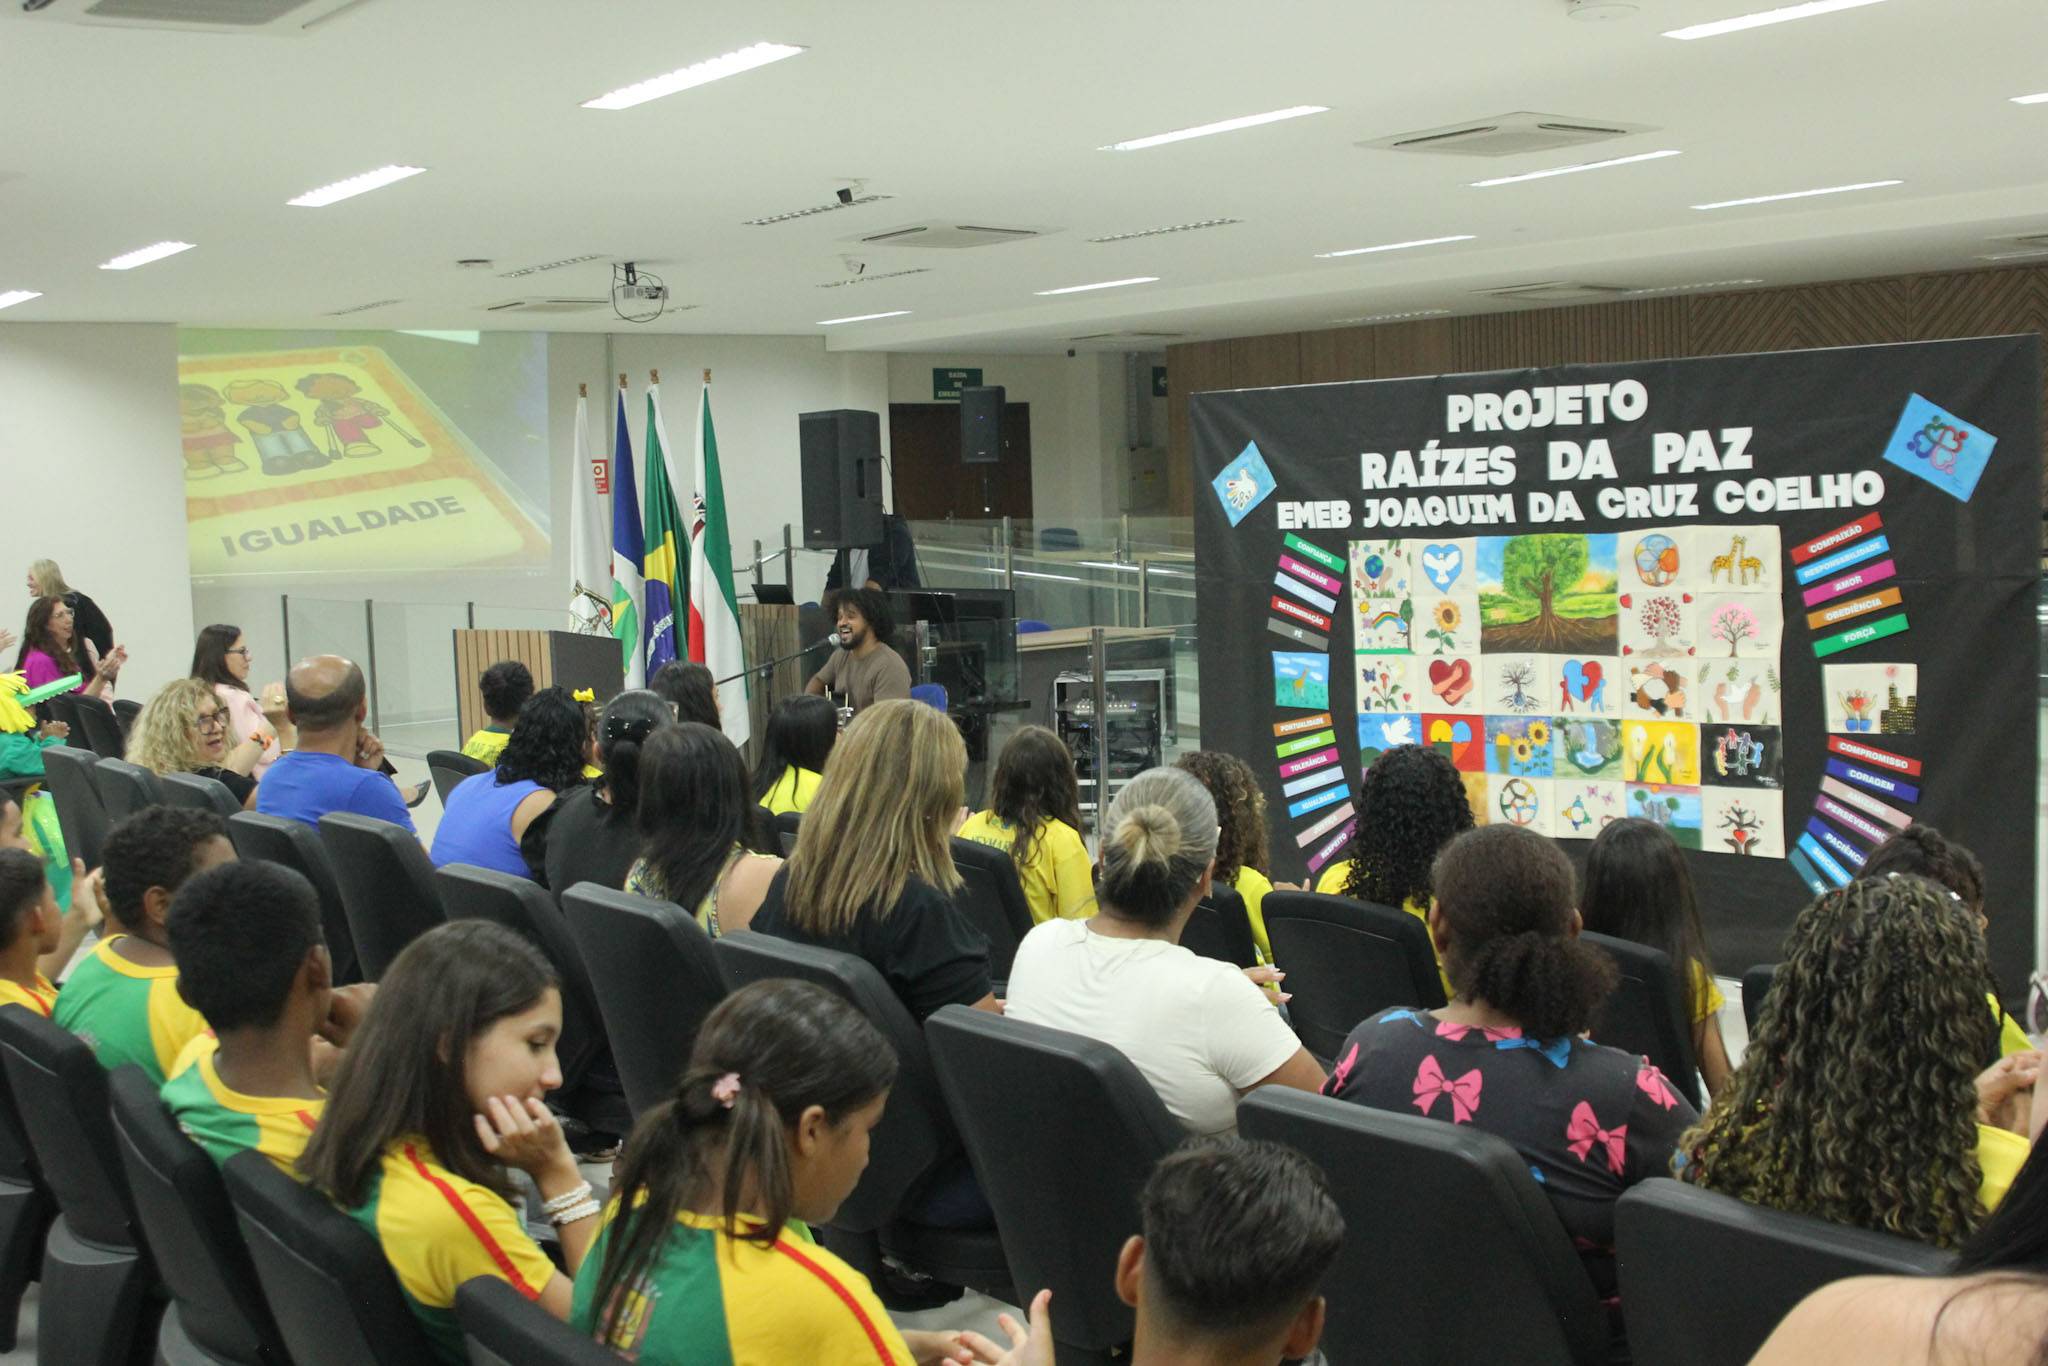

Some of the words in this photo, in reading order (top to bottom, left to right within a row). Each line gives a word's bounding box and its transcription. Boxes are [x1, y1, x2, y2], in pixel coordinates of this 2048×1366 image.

[1447, 379, 1648, 433] PROJETO
[1361, 440, 1517, 490] RAÍZES
[1548, 438, 1618, 481] DA
[1652, 427, 1753, 474] PAZ
[1277, 500, 1352, 530] EMEB
[1363, 493, 1517, 528] JOAQUIM
[1528, 490, 1585, 523] DA
[1597, 483, 1699, 519] CRUZ
[1714, 470, 1885, 515] COELHO
[221, 495, 466, 557] IGUALDADE
[1808, 523, 1862, 553] COMPAIXÃO
[1296, 541, 1333, 565] CONFIANÇA
[1804, 541, 1883, 579] RESPONSABILIDADE
[1291, 562, 1329, 586] HUMILDADE
[1834, 575, 1863, 591] AMOR
[1824, 597, 1882, 621] OBEDIÊNCIA
[1842, 626, 1877, 643] FORÇA
[1279, 717, 1324, 732] PONTUALIDADE
[1290, 755, 1328, 772] TOLERÂNCIA
[1837, 741, 1909, 770] COMPROMISSO
[1847, 769, 1895, 791] CORAGEM
[1824, 801, 1889, 845] PERSEVERANÇ
[1319, 832, 1347, 858] RESPEITO
[1811, 846, 1848, 883] SINCERID
